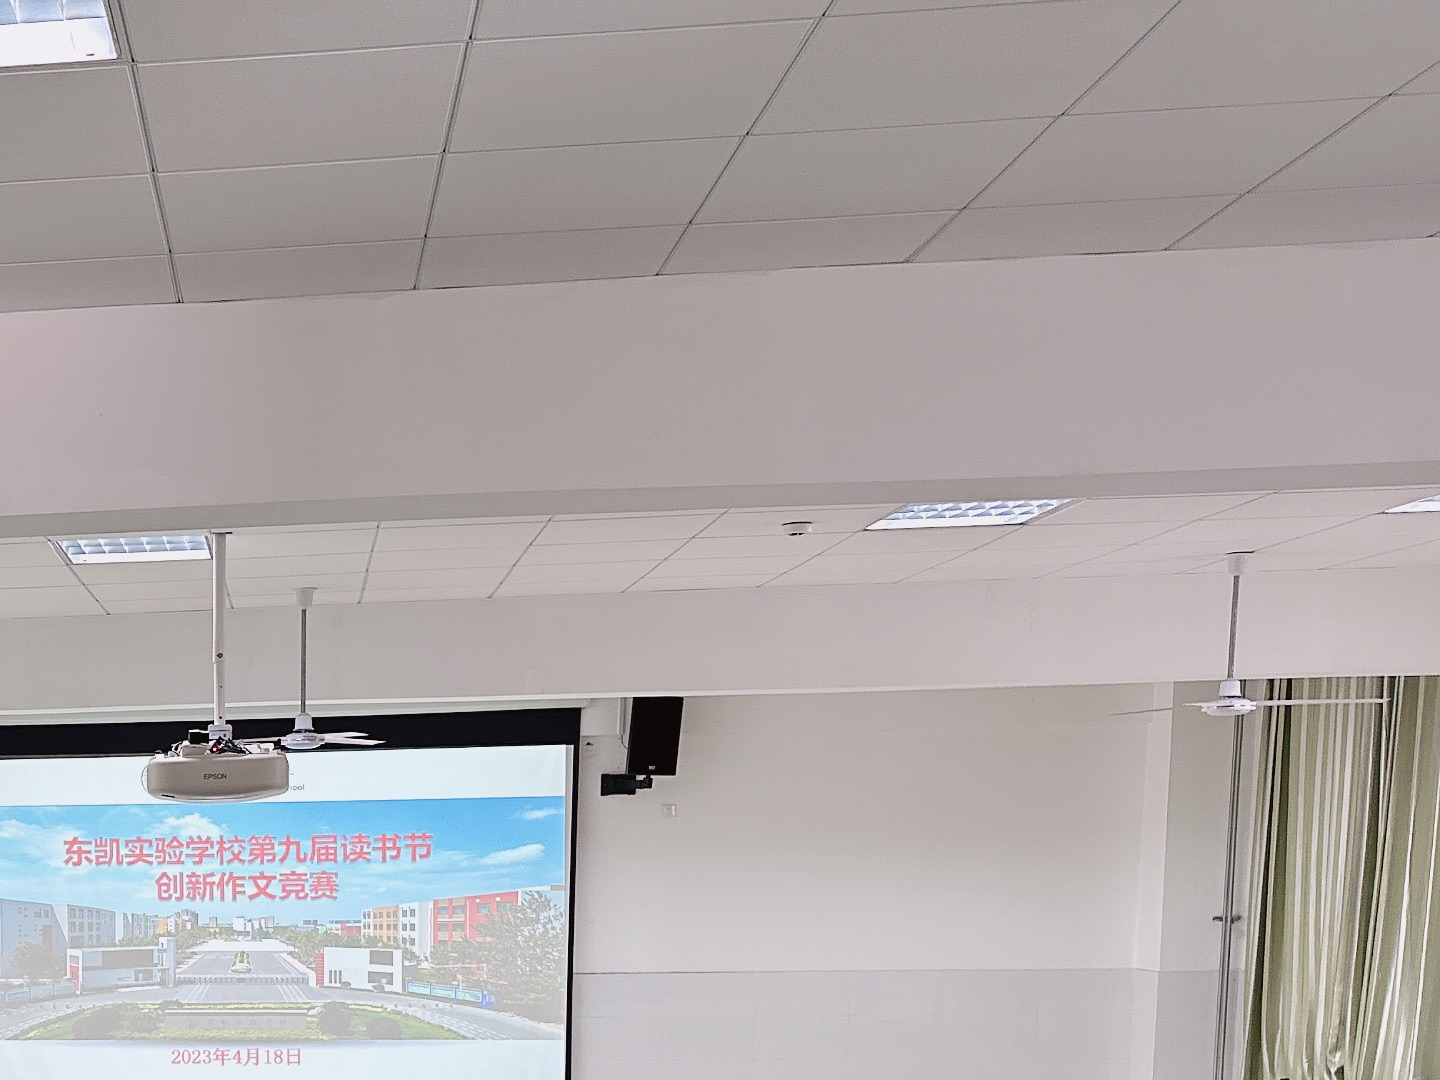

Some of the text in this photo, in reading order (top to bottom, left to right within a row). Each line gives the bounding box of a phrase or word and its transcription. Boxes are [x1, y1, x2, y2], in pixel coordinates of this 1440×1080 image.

[63, 832, 433, 867] 东凯实验学校第九届读书节
[155, 870, 339, 901] 创新作文竞赛
[171, 1048, 301, 1067] 2023年4月18日
